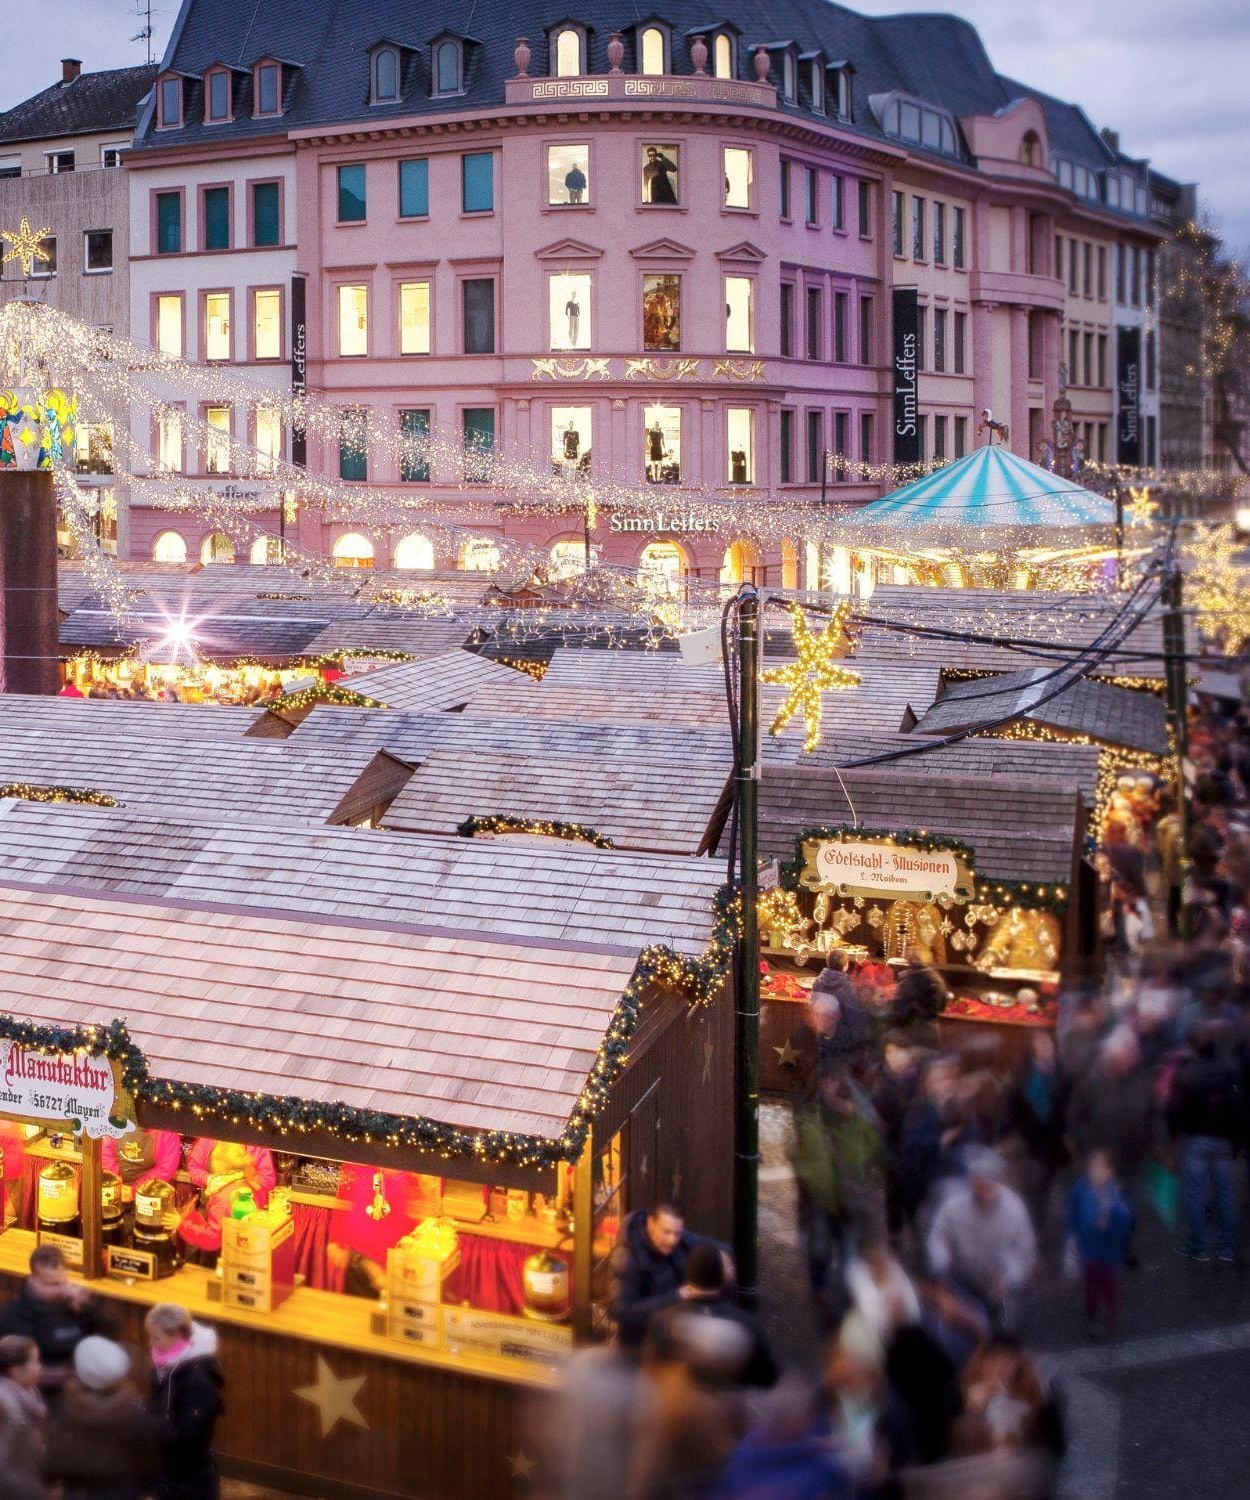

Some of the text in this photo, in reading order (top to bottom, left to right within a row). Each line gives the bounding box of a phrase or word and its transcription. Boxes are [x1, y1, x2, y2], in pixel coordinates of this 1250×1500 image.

[896, 333, 916, 436] SinnLeffers
[1121, 363, 1138, 443] SinnLeffers
[610, 512, 720, 532] SinnLeffers
[824, 848, 882, 870] Edelstahl
[892, 854, 950, 874] Illusionen
[5, 1042, 109, 1092] Manufaktur
[33, 1091, 63, 1111] 56727
[64, 1096, 101, 1121] Mayen
